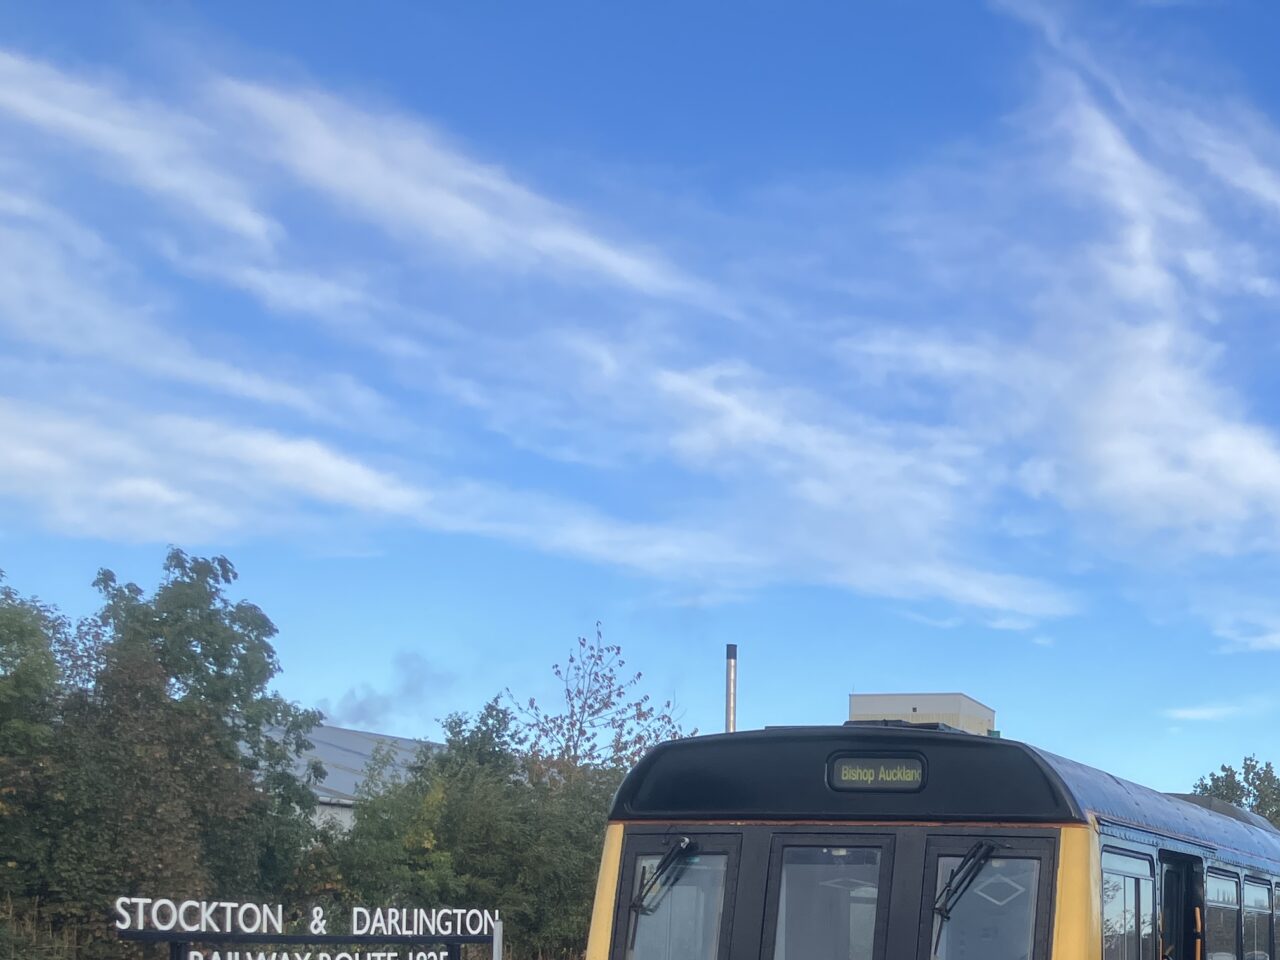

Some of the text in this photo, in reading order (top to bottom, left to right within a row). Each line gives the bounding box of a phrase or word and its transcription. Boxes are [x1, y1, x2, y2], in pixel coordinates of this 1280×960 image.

[841, 765, 875, 784] Bishop
[115, 896, 501, 936] STOCKTON & DARLINGTON
